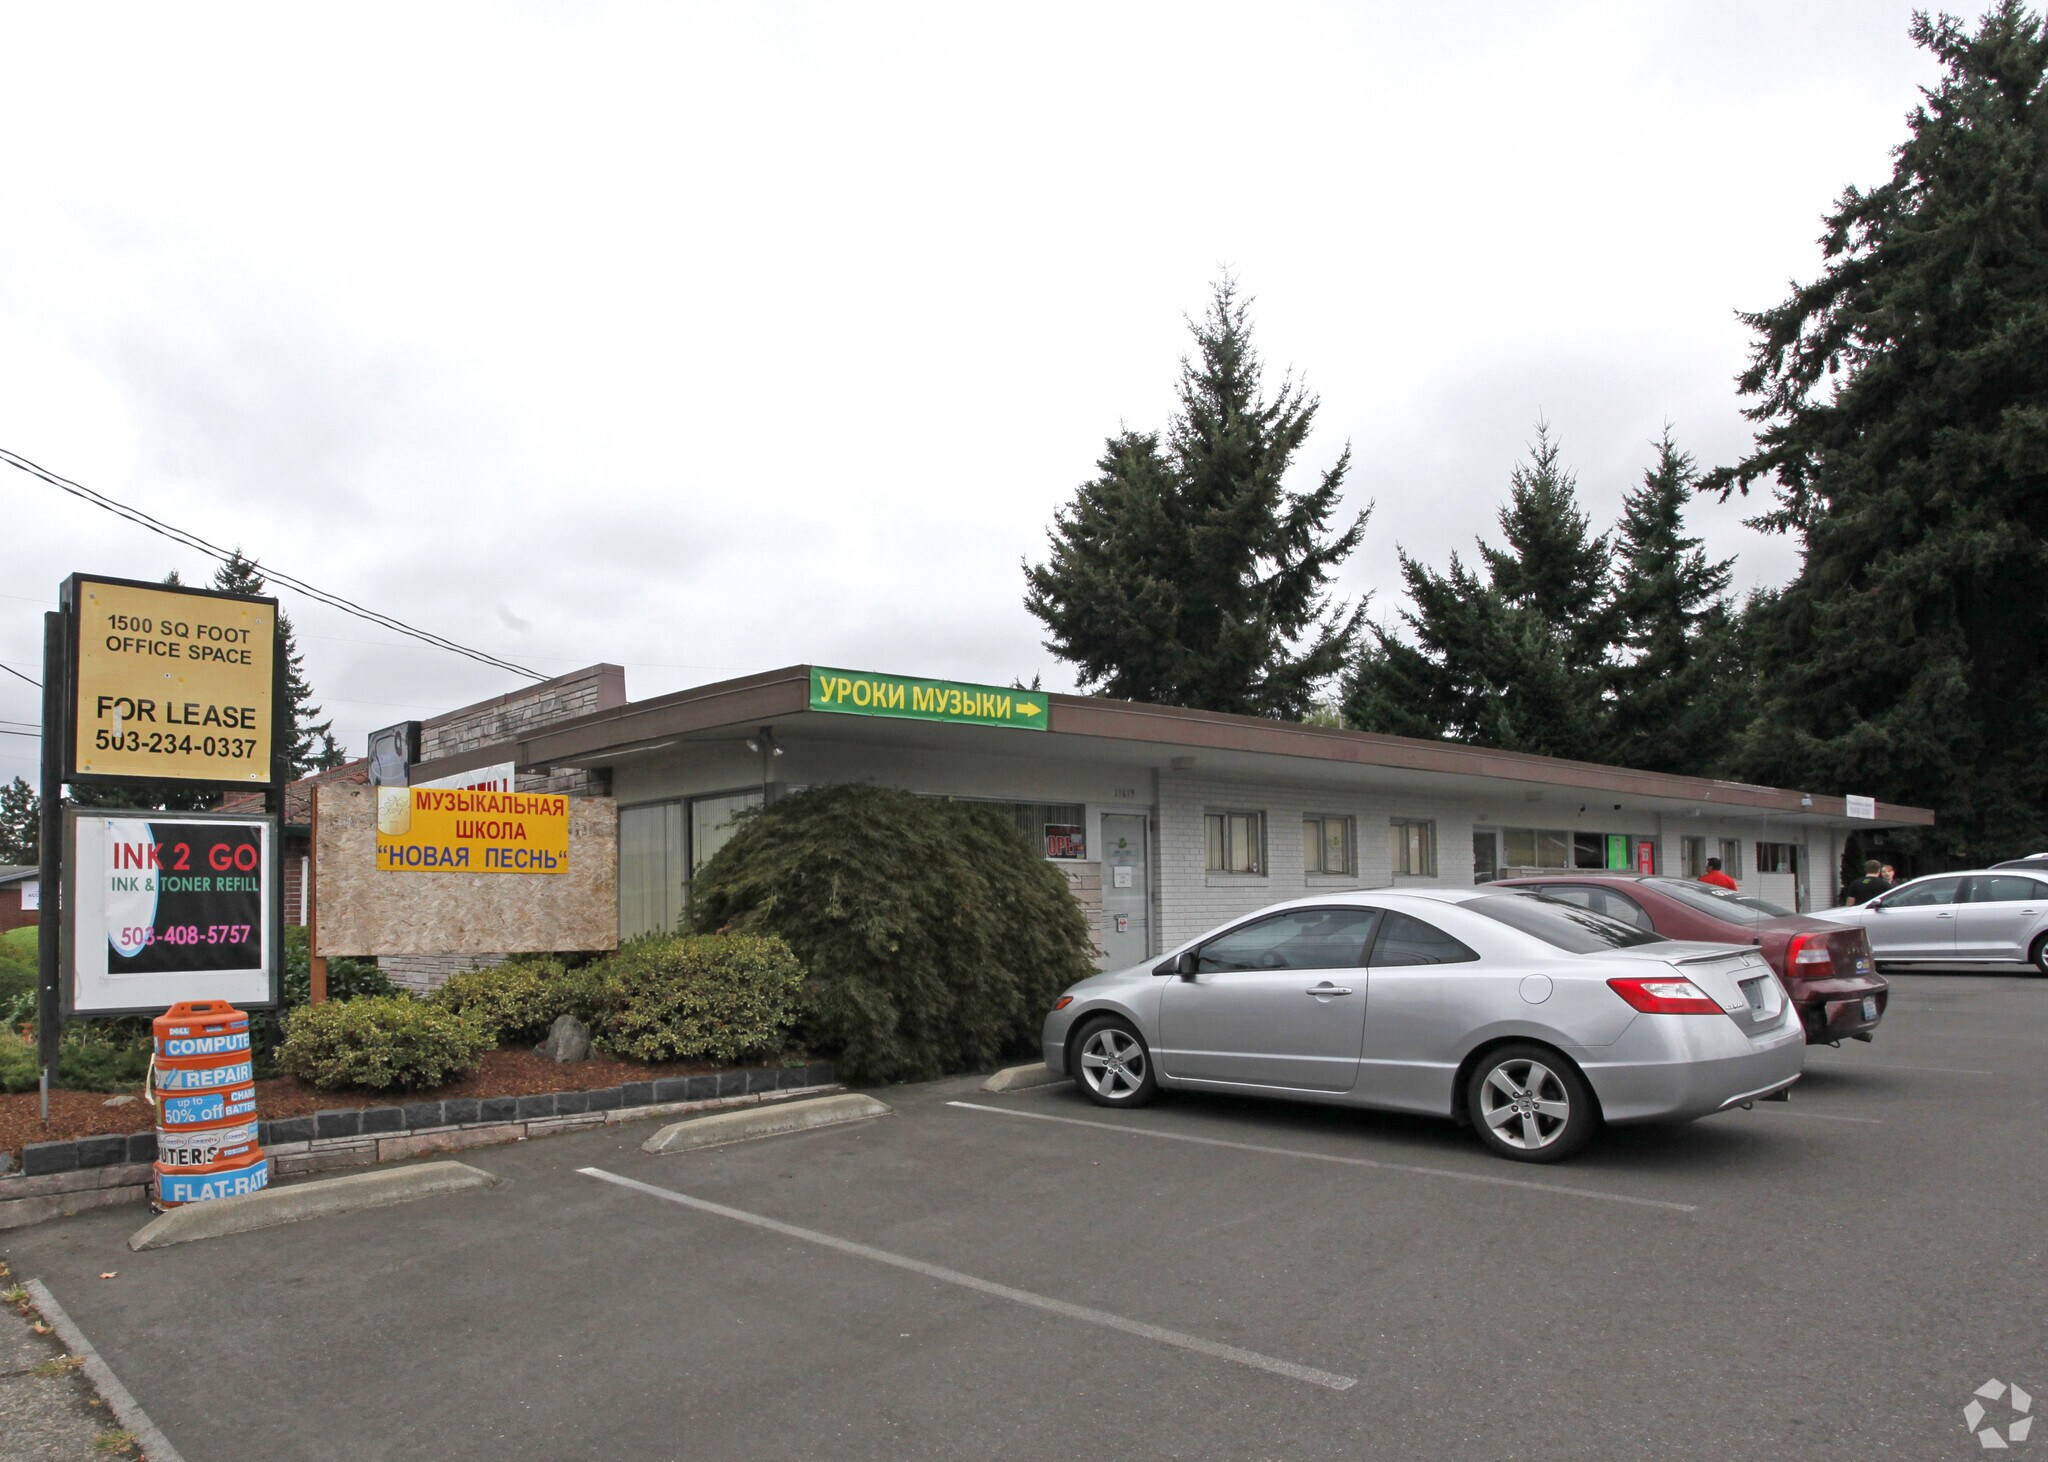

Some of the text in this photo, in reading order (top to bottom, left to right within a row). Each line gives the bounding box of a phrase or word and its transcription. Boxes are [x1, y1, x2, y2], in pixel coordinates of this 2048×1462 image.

[107, 614, 251, 645] 1500 SQ FOOT
[106, 635, 252, 665] OFFICE SPACE
[819, 676, 1012, 720] УРОКИ МУЗЫКИ
[97, 696, 257, 730] FOR LEASE
[95, 729, 257, 759] 503-234-0337
[416, 791, 565, 817] МУЗЫКАЛЬНАЯ
[455, 821, 527, 841] ШКОЛА
[113, 842, 258, 872] INK 2 GO
[111, 877, 259, 892] INK & TONER REFILL
[120, 924, 251, 945] 503-408-5757
[168, 1032, 250, 1055] COMPUTE
[186, 1066, 249, 1087] REPAIR
[165, 1104, 224, 1124] 50% off
[177, 1097, 203, 1109] up to
[173, 1167, 268, 1202] FLAT-RATE
